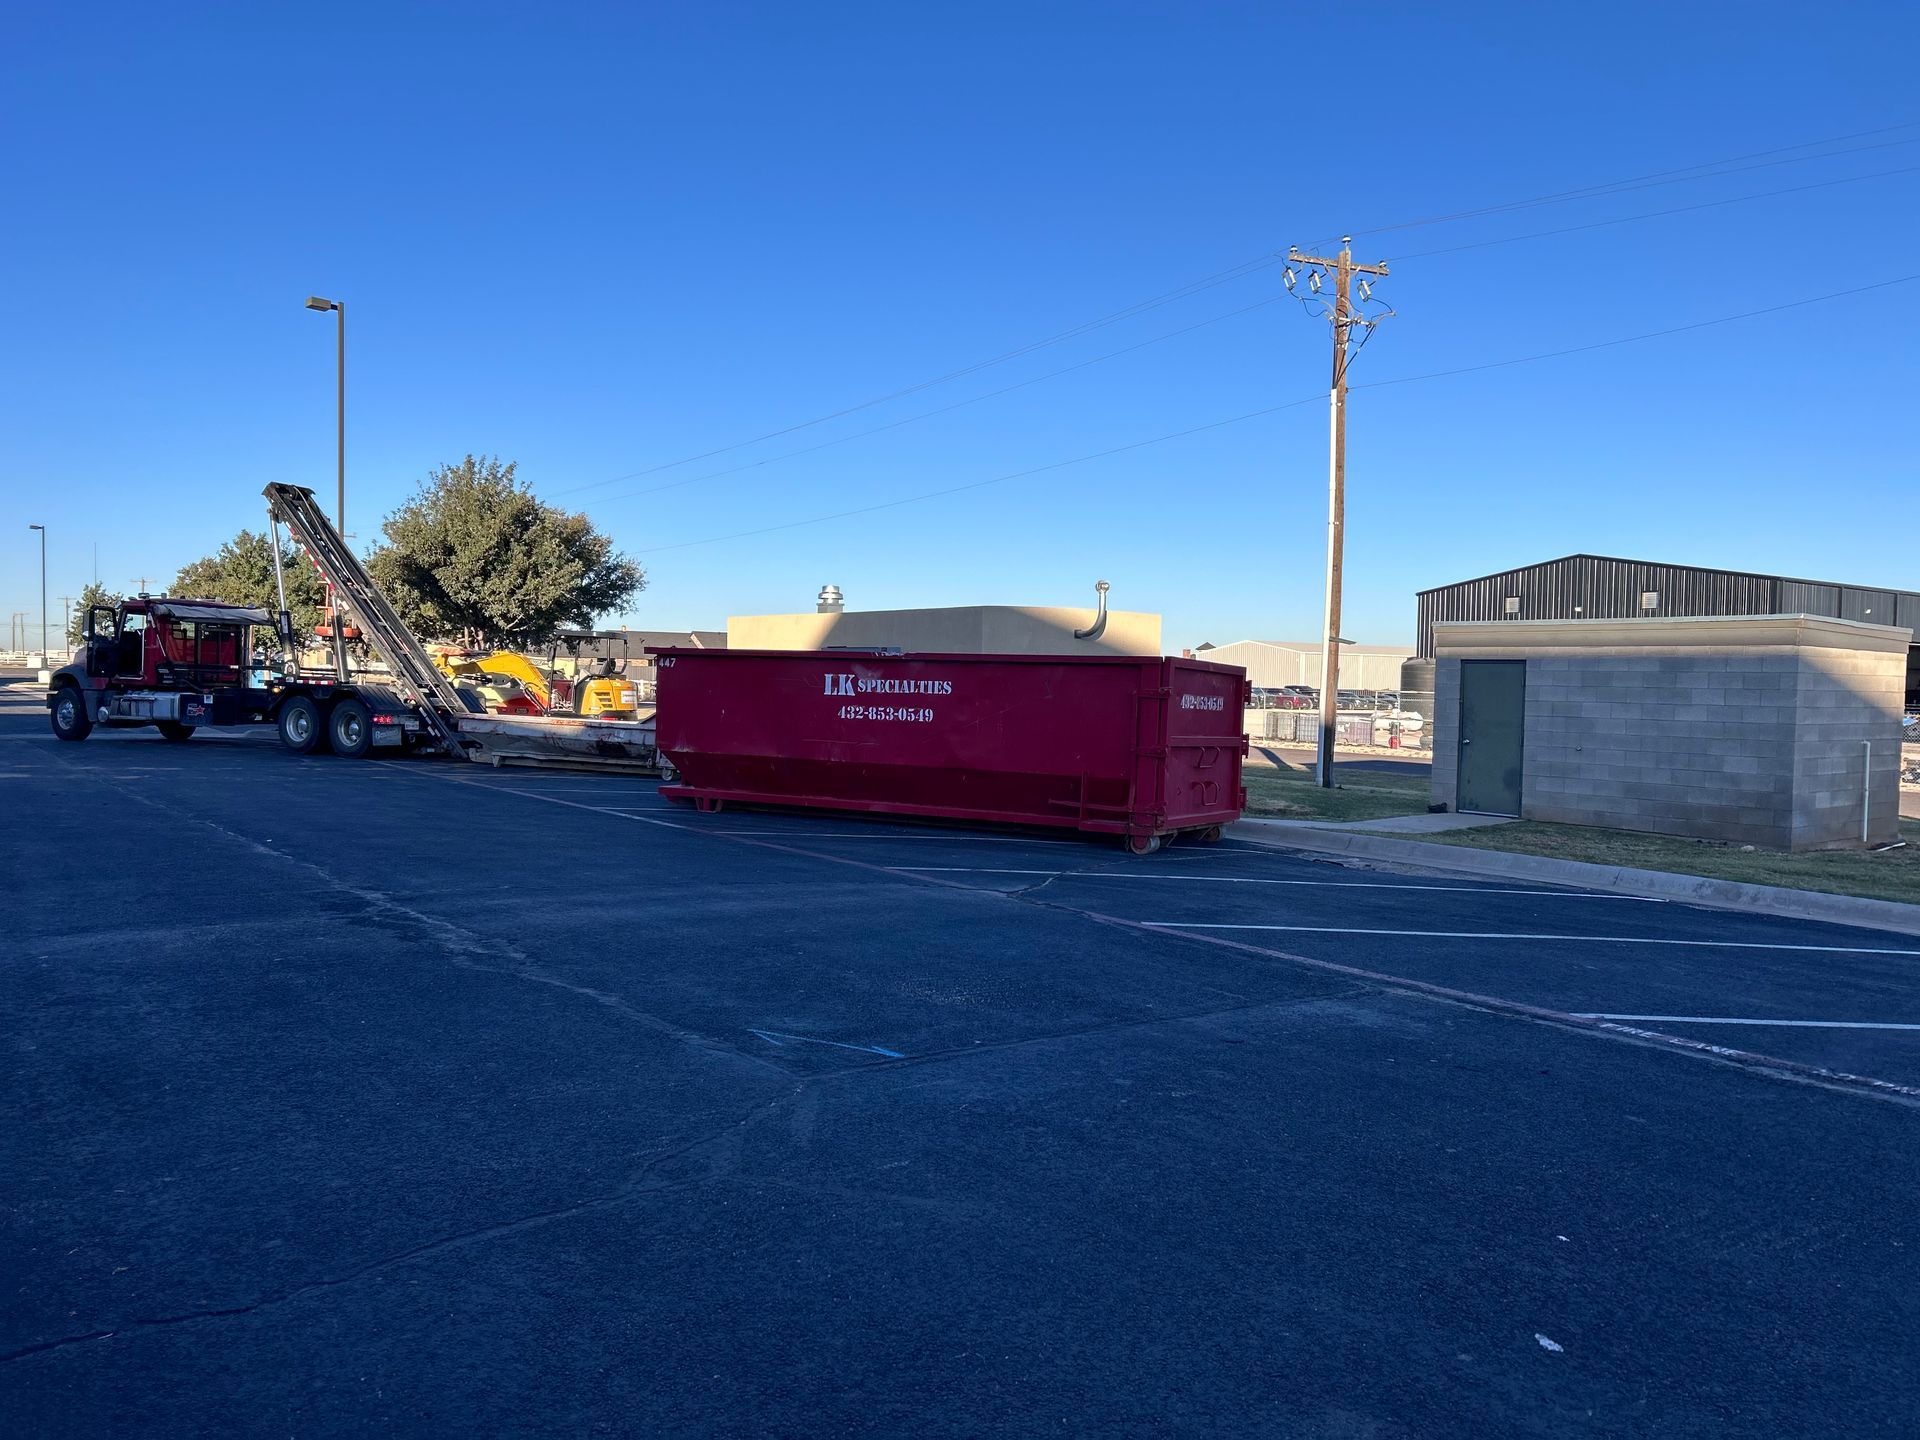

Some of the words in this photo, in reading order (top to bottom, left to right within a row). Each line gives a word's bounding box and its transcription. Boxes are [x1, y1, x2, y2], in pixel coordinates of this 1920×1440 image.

[658, 657, 676, 668] 447
[823, 673, 856, 696] LK
[857, 678, 952, 695] SPECIALTIES
[837, 705, 934, 722] 432-853-0549
